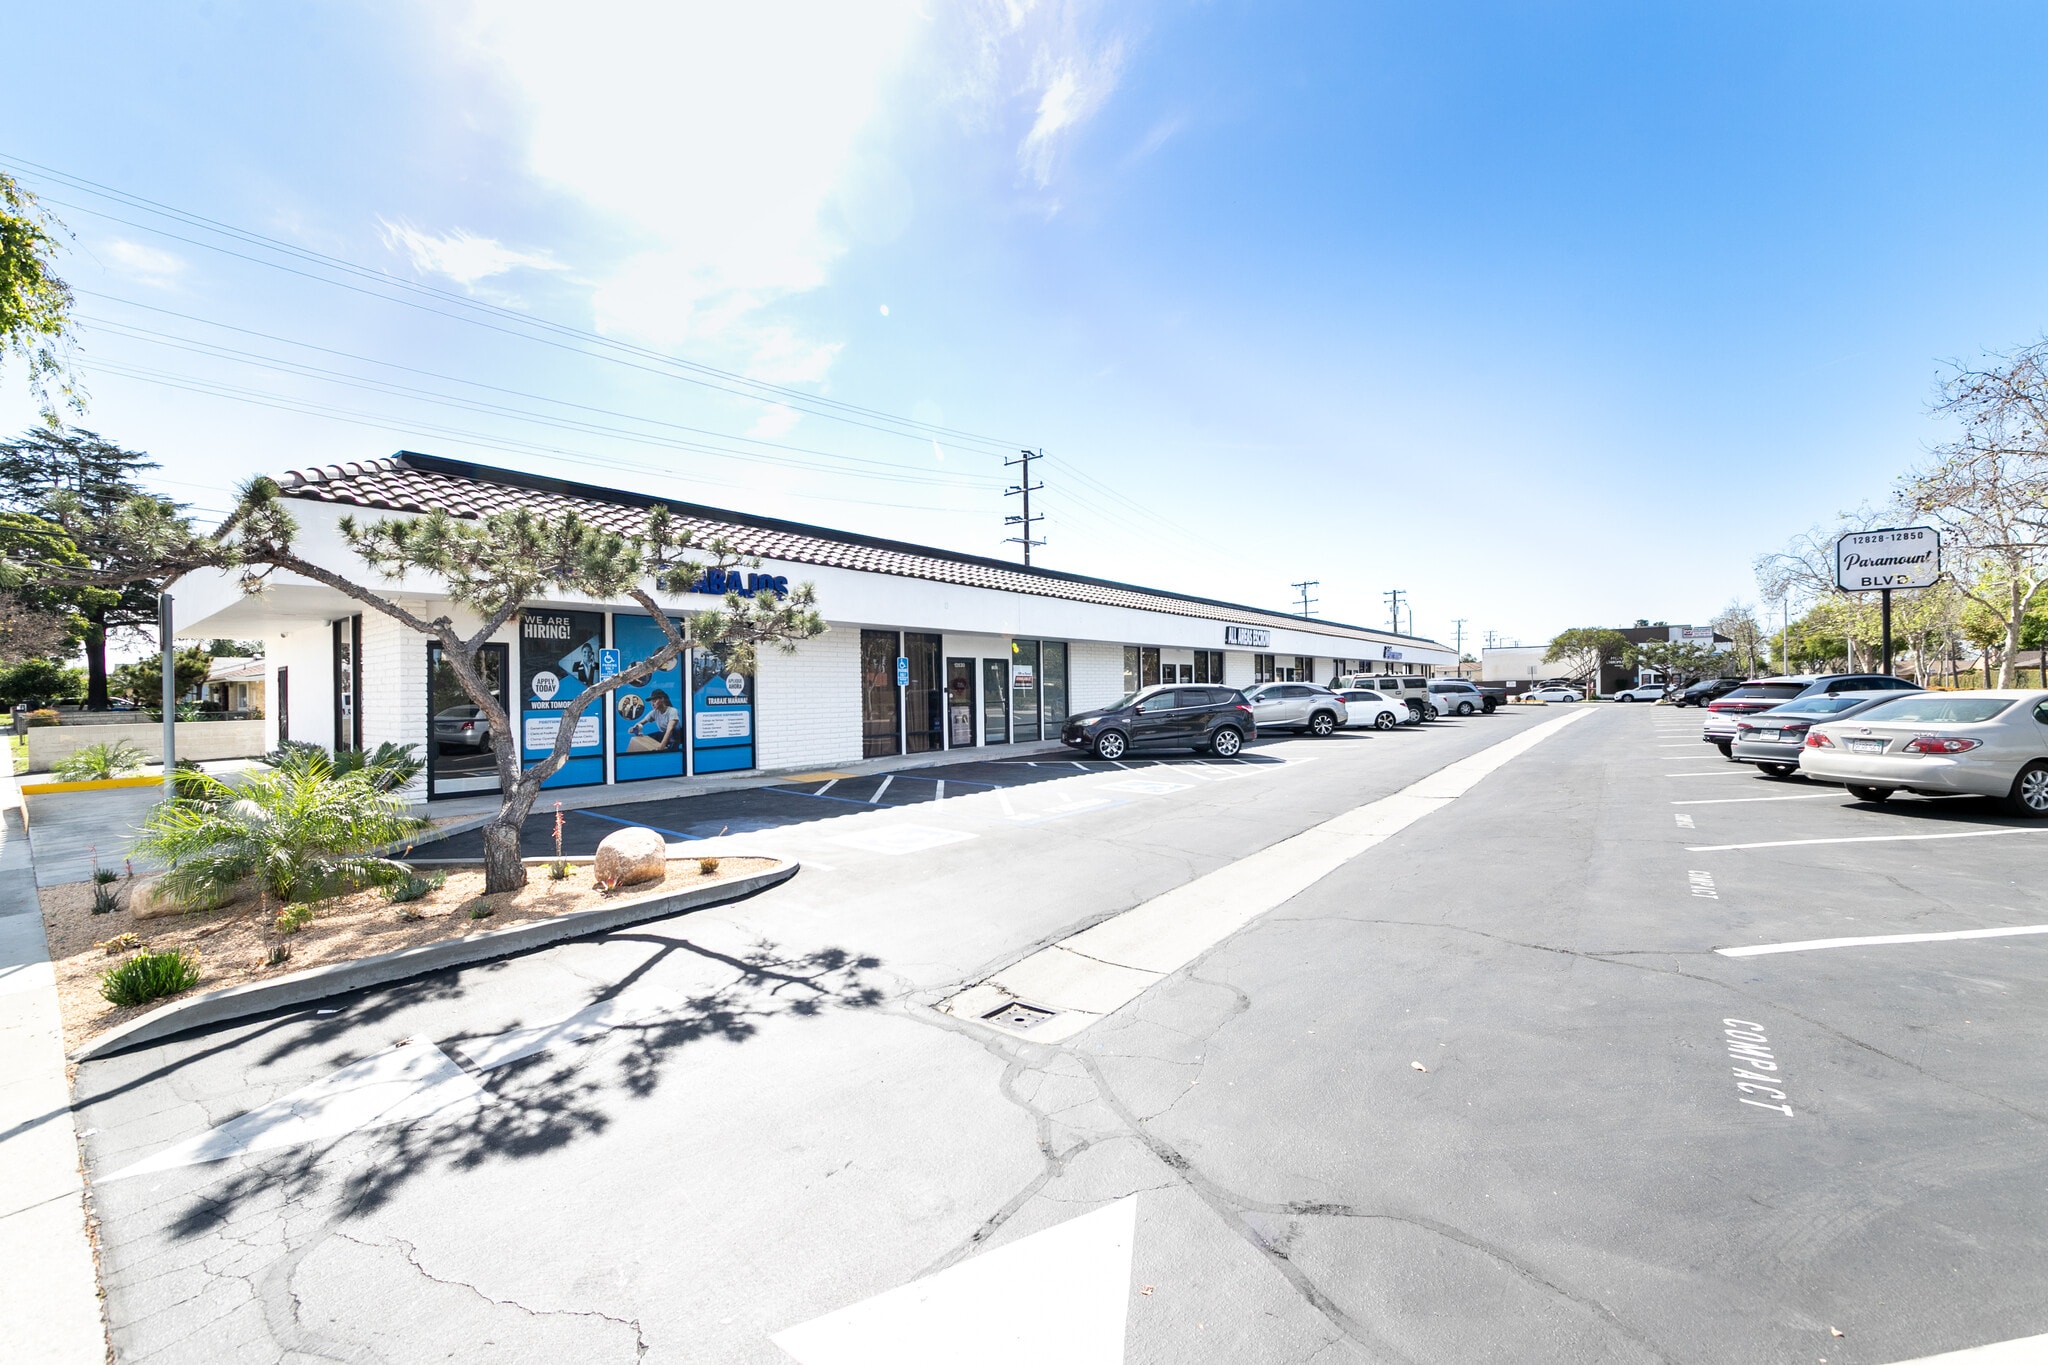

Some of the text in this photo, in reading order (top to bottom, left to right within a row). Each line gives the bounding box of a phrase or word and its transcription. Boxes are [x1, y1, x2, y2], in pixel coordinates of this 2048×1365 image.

[1853, 532, 1924, 545] 12828-12850
[1843, 550, 1933, 571] Paramount
[655, 563, 788, 601] ABAJOS
[524, 616, 570, 626] WE ARE
[524, 624, 571, 639] HIRING!
[531, 701, 549, 709] WORK
[1722, 1018, 1794, 1117] COMPACT
